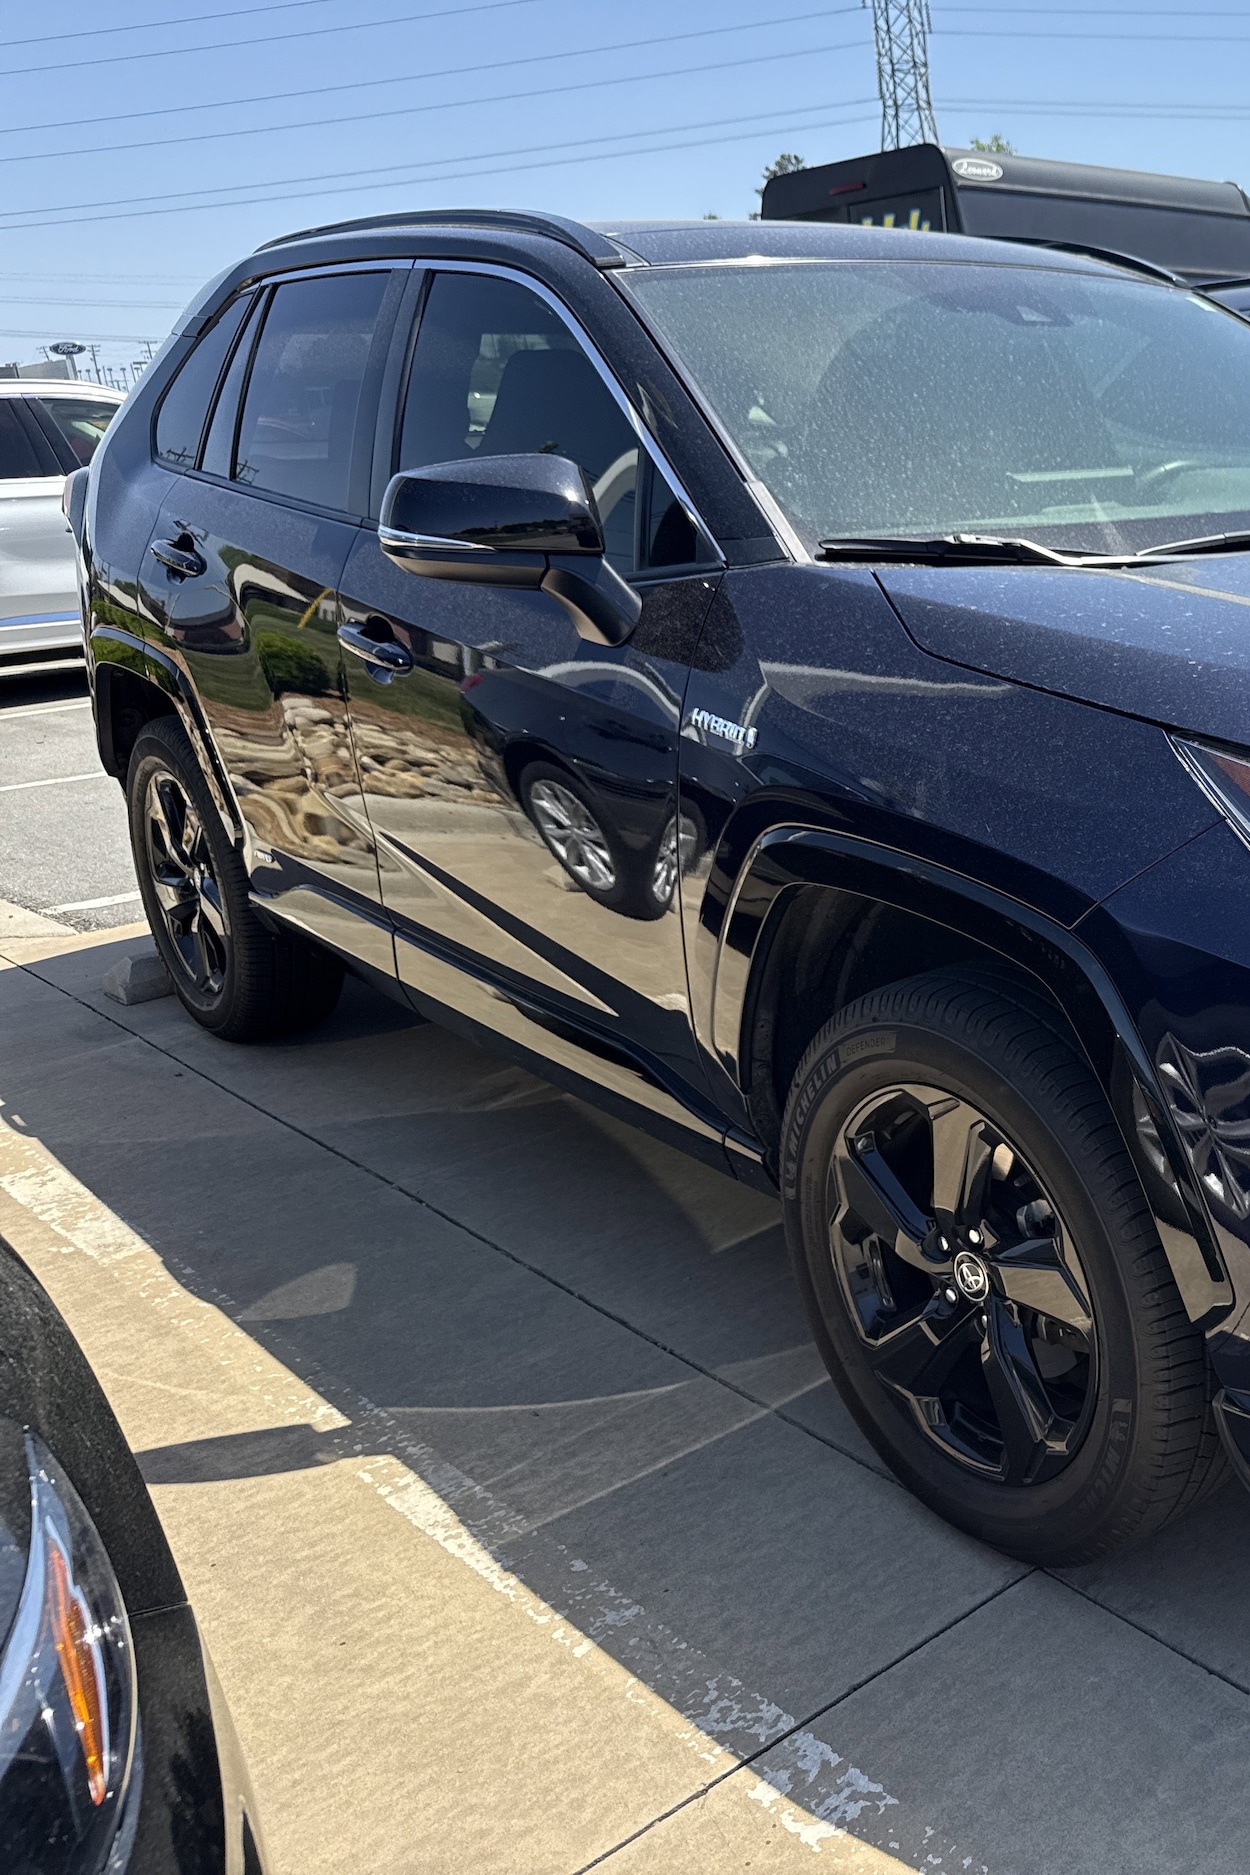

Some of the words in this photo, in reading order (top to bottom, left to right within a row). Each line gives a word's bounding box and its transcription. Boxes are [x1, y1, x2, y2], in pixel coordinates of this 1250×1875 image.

[57, 344, 80, 354] Ford
[692, 707, 746, 744] HYBRID
[789, 1051, 839, 1156] MICHELIN
[846, 1036, 886, 1057] DEFENDER
